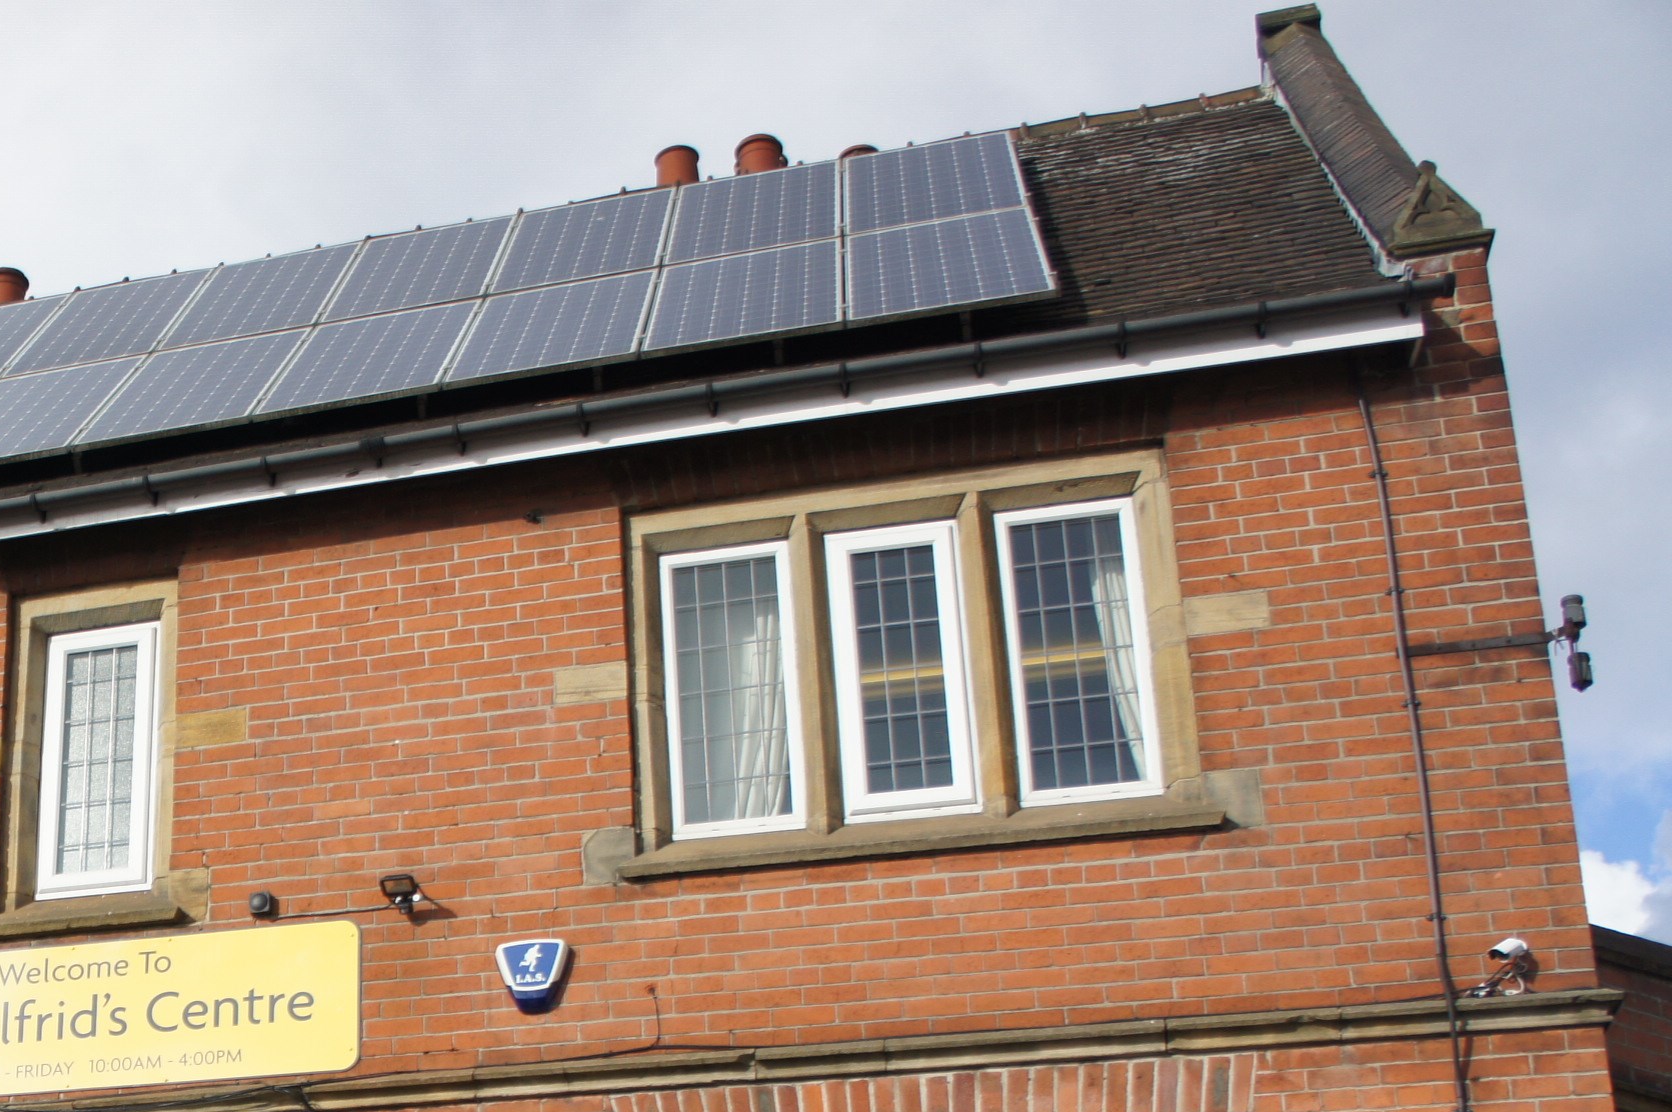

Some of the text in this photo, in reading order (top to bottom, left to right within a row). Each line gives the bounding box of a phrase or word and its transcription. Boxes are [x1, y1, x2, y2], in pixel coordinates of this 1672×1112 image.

[138, 950, 172, 975] To
[146, 988, 315, 1033] Centre
[16, 1061, 75, 1079] FRIDAY
[89, 1055, 162, 1074] 10:00AM
[179, 1048, 243, 1067] 4:00PM
